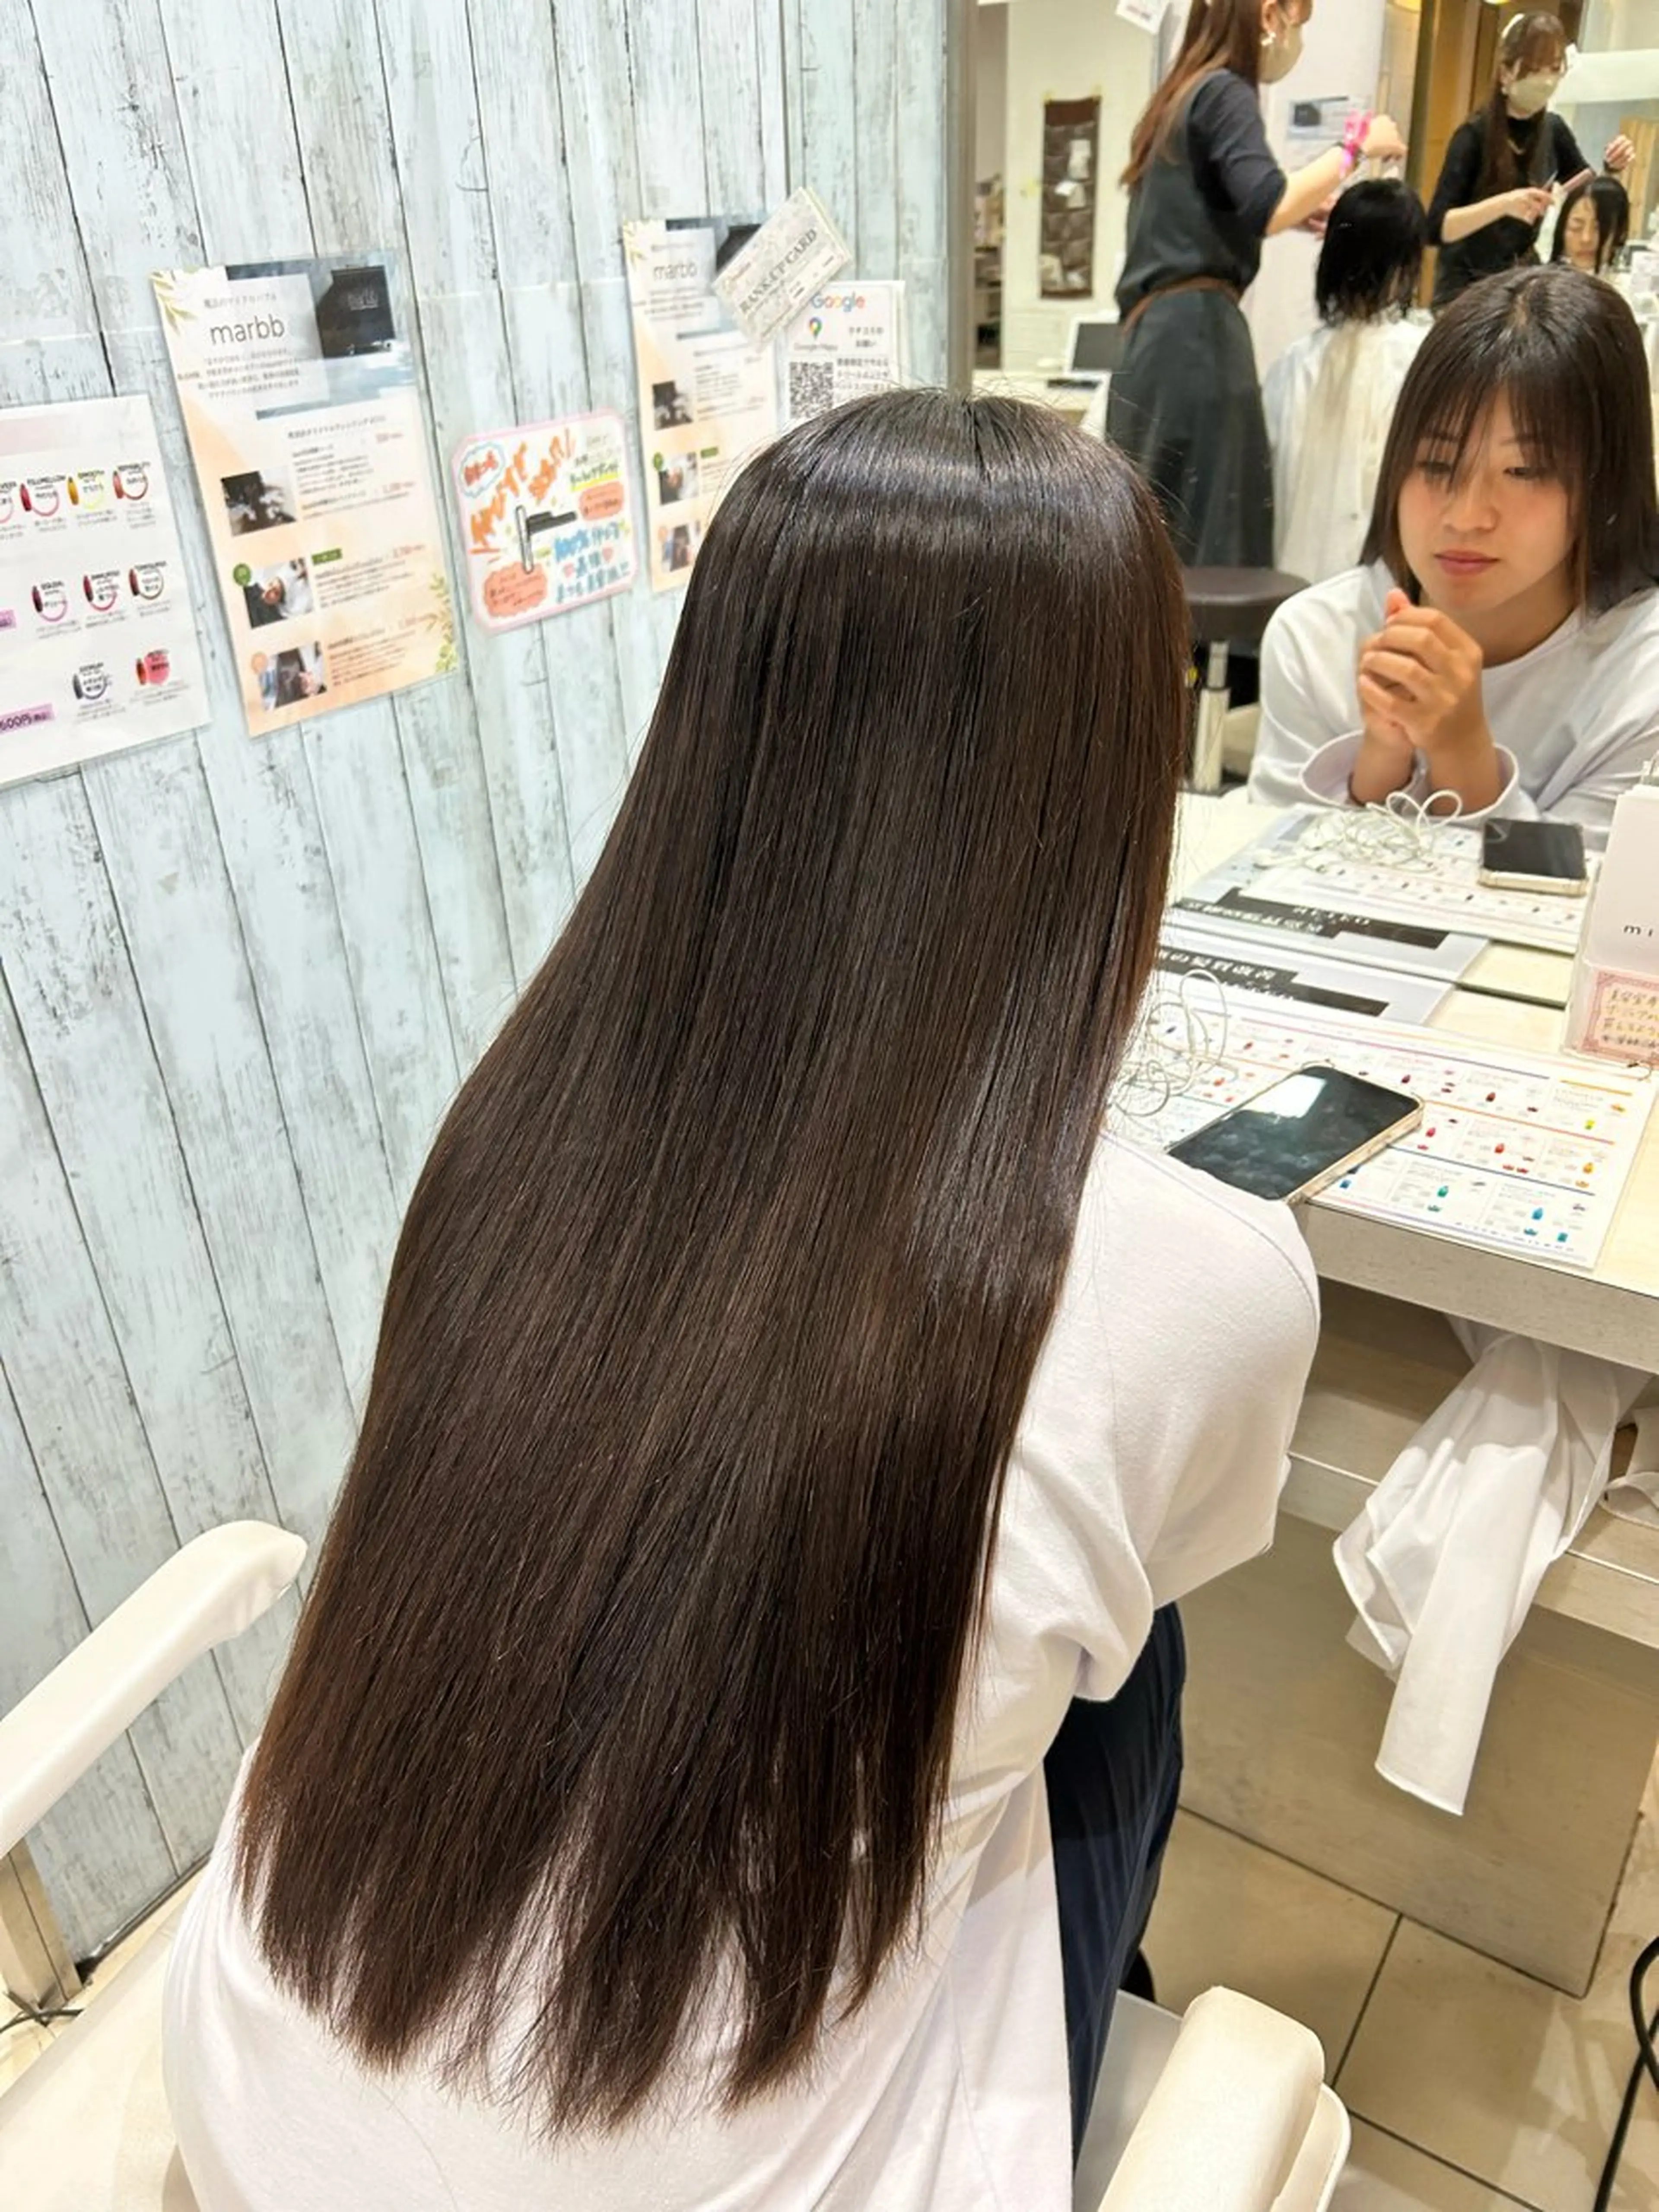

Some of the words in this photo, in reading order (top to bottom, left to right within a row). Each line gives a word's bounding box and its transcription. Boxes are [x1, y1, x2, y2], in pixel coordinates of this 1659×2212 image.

[785, 228, 817, 264] CARD
[810, 291, 866, 312] Google
[210, 313, 285, 346] marbb
